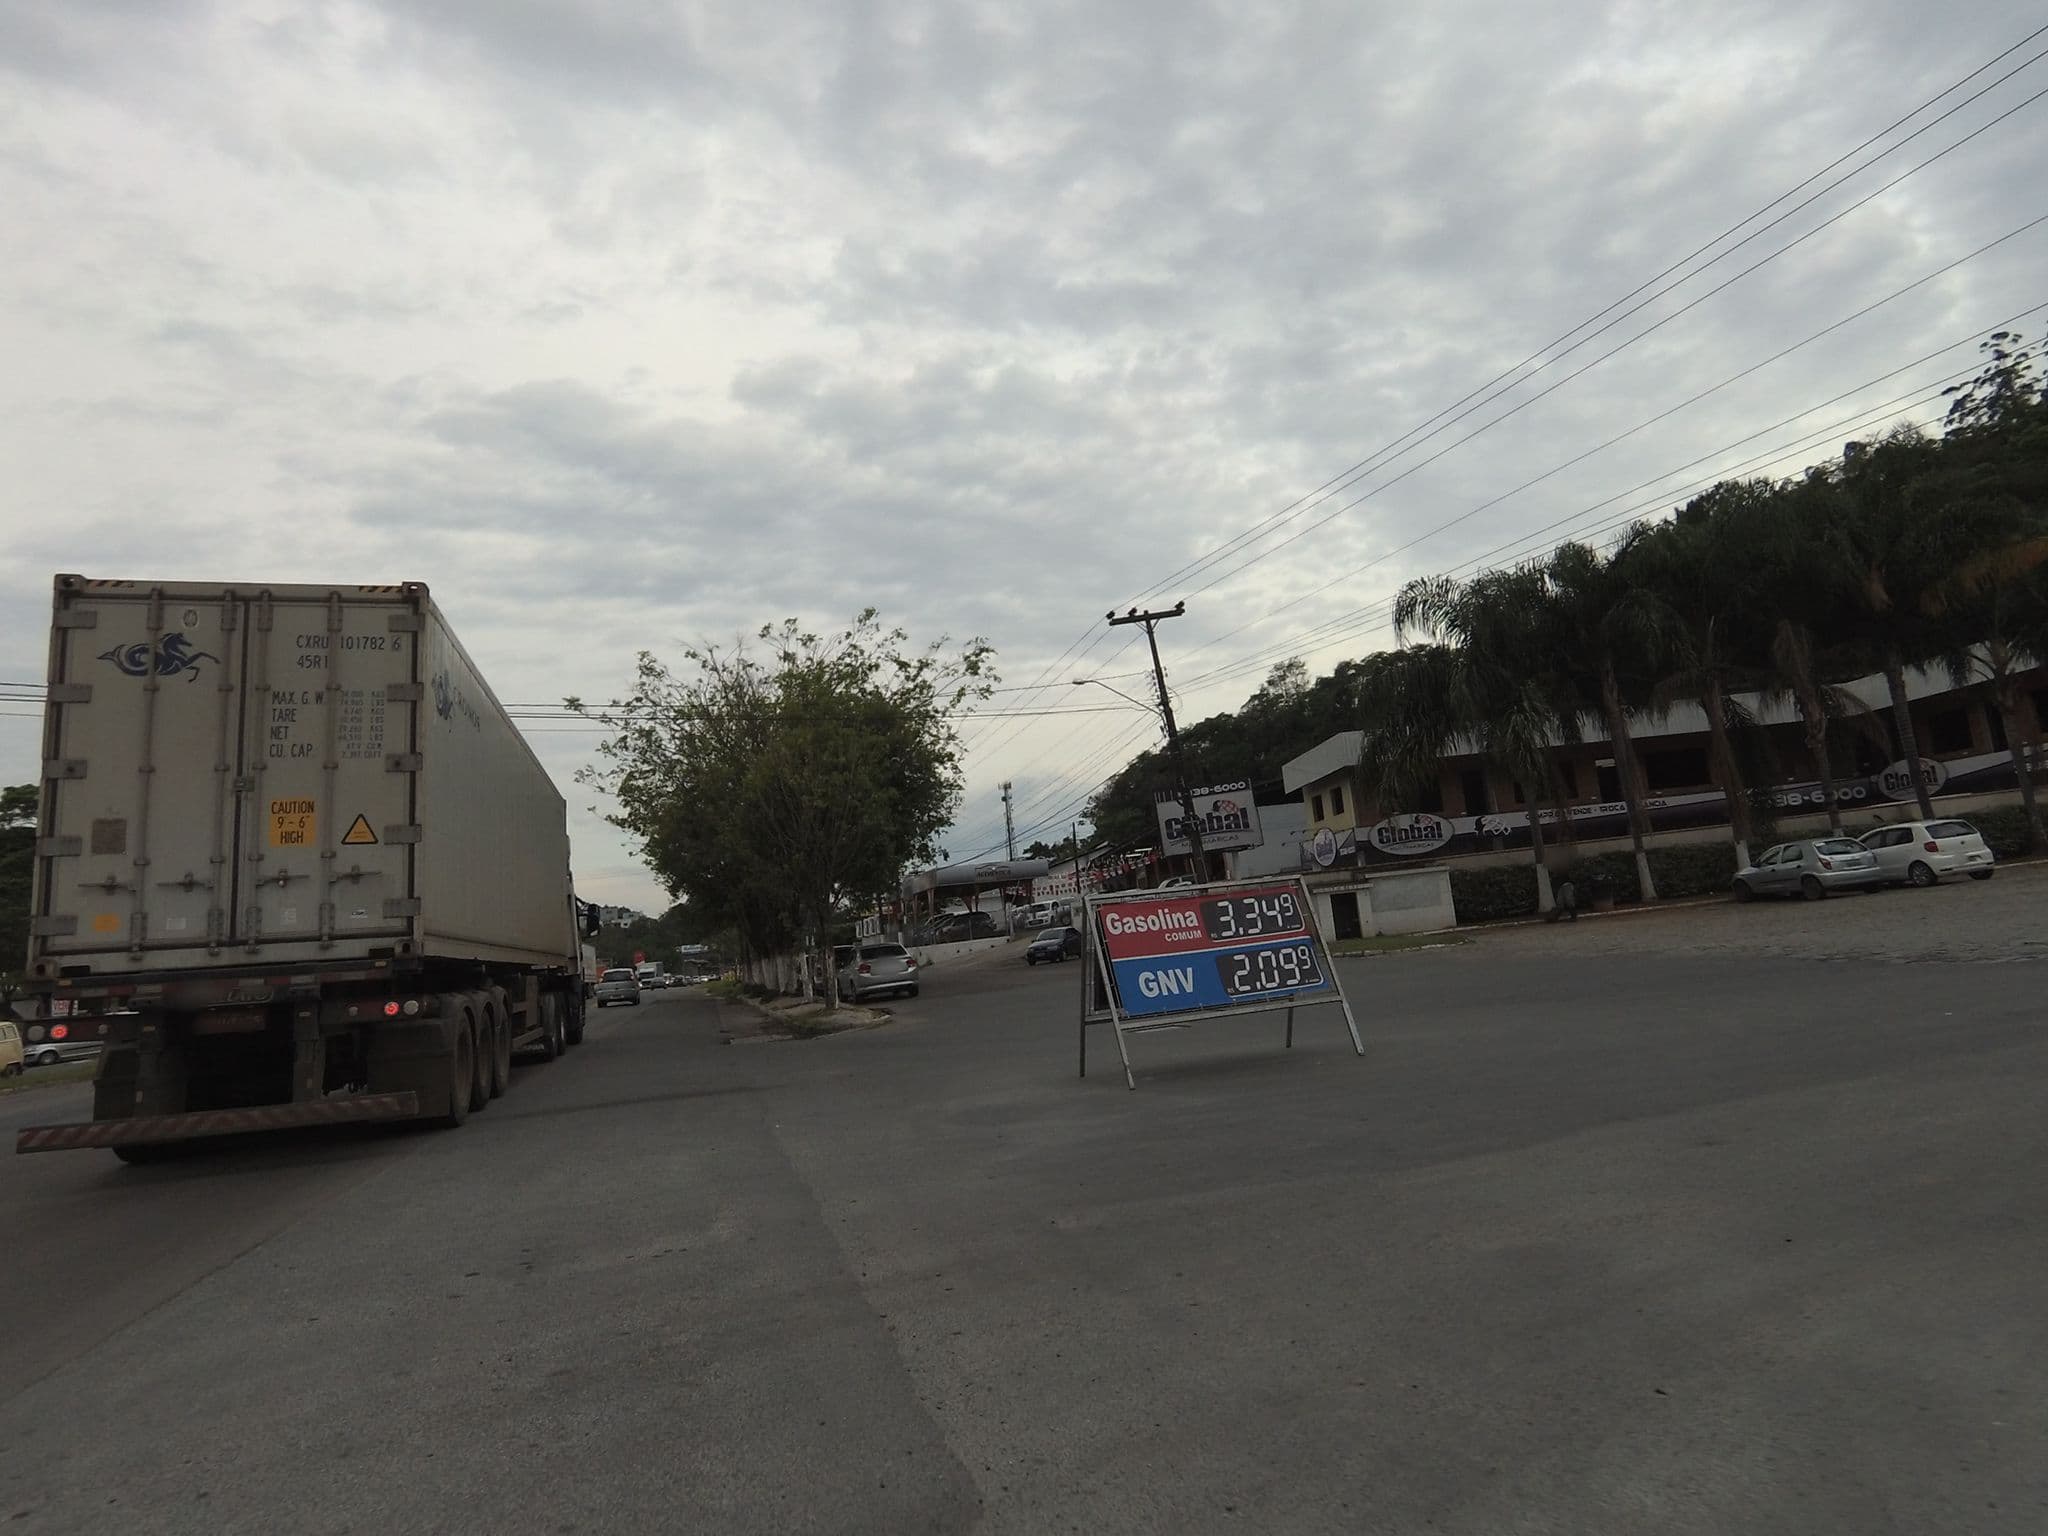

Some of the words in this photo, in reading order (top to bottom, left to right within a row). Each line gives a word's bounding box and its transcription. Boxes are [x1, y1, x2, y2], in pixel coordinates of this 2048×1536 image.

[295, 634, 329, 649] CXRU
[340, 636, 386, 651] 101782
[392, 636, 402, 651] 6
[271, 708, 297, 723] TARE
[270, 725, 290, 740] NET
[1884, 765, 1938, 790] Gloal
[270, 800, 315, 815] CAUTION
[1599, 804, 1627, 813] TROCA
[1165, 807, 1250, 840] Gbal
[280, 830, 304, 844] HIGH
[1377, 821, 1443, 845] Global
[1105, 909, 1200, 936] Gasolina
[1164, 929, 1202, 943] COMUM
[1138, 966, 1195, 999] GNV
